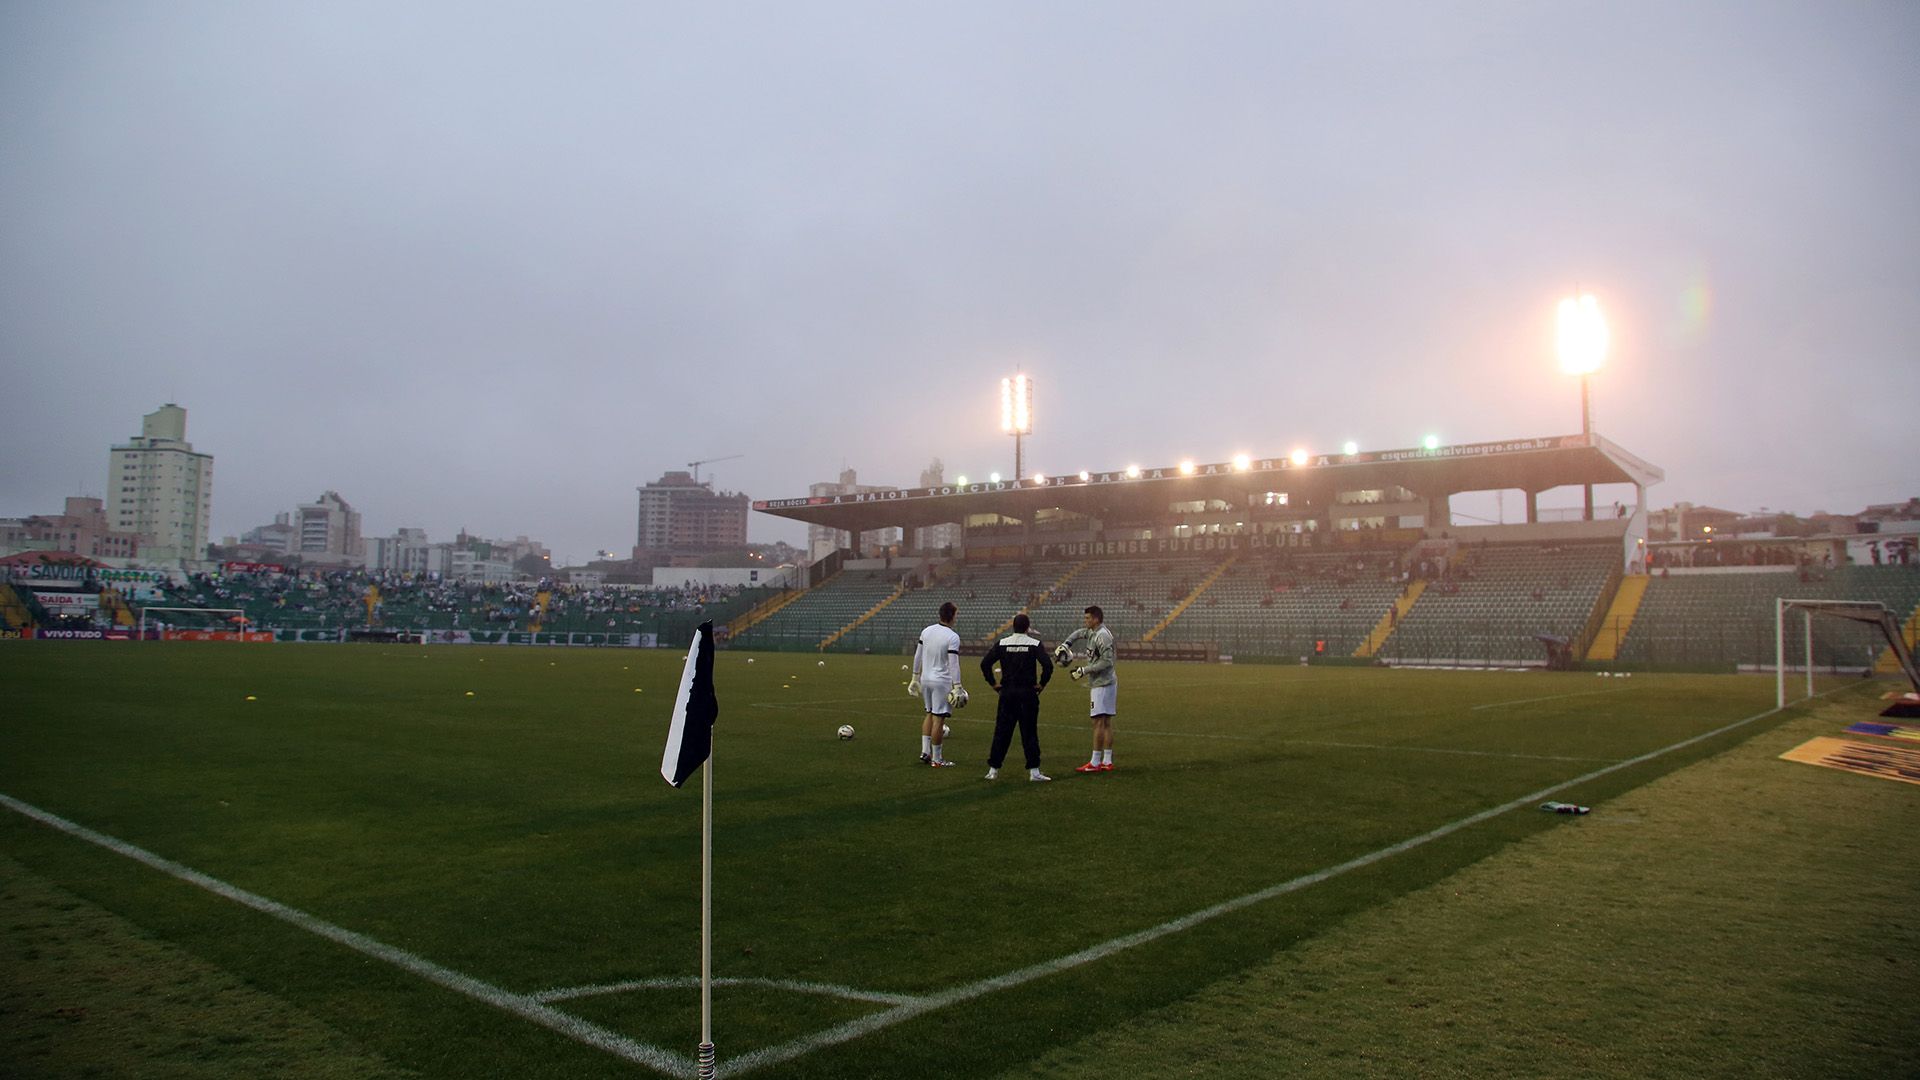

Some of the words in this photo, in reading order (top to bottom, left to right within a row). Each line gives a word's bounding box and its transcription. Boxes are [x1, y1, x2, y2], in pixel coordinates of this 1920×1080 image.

[856, 490, 909, 502] MAIOR
[928, 480, 1021, 496] TORCIDA
[1190, 456, 1329, 477] ATRIA
[1042, 540, 1149, 556] FUEIRENSE
[1159, 537, 1239, 552] FUTEBOL
[1251, 532, 1311, 548] CLUBE
[44, 630, 72, 638] VIVO
[74, 630, 102, 639] TUDO
